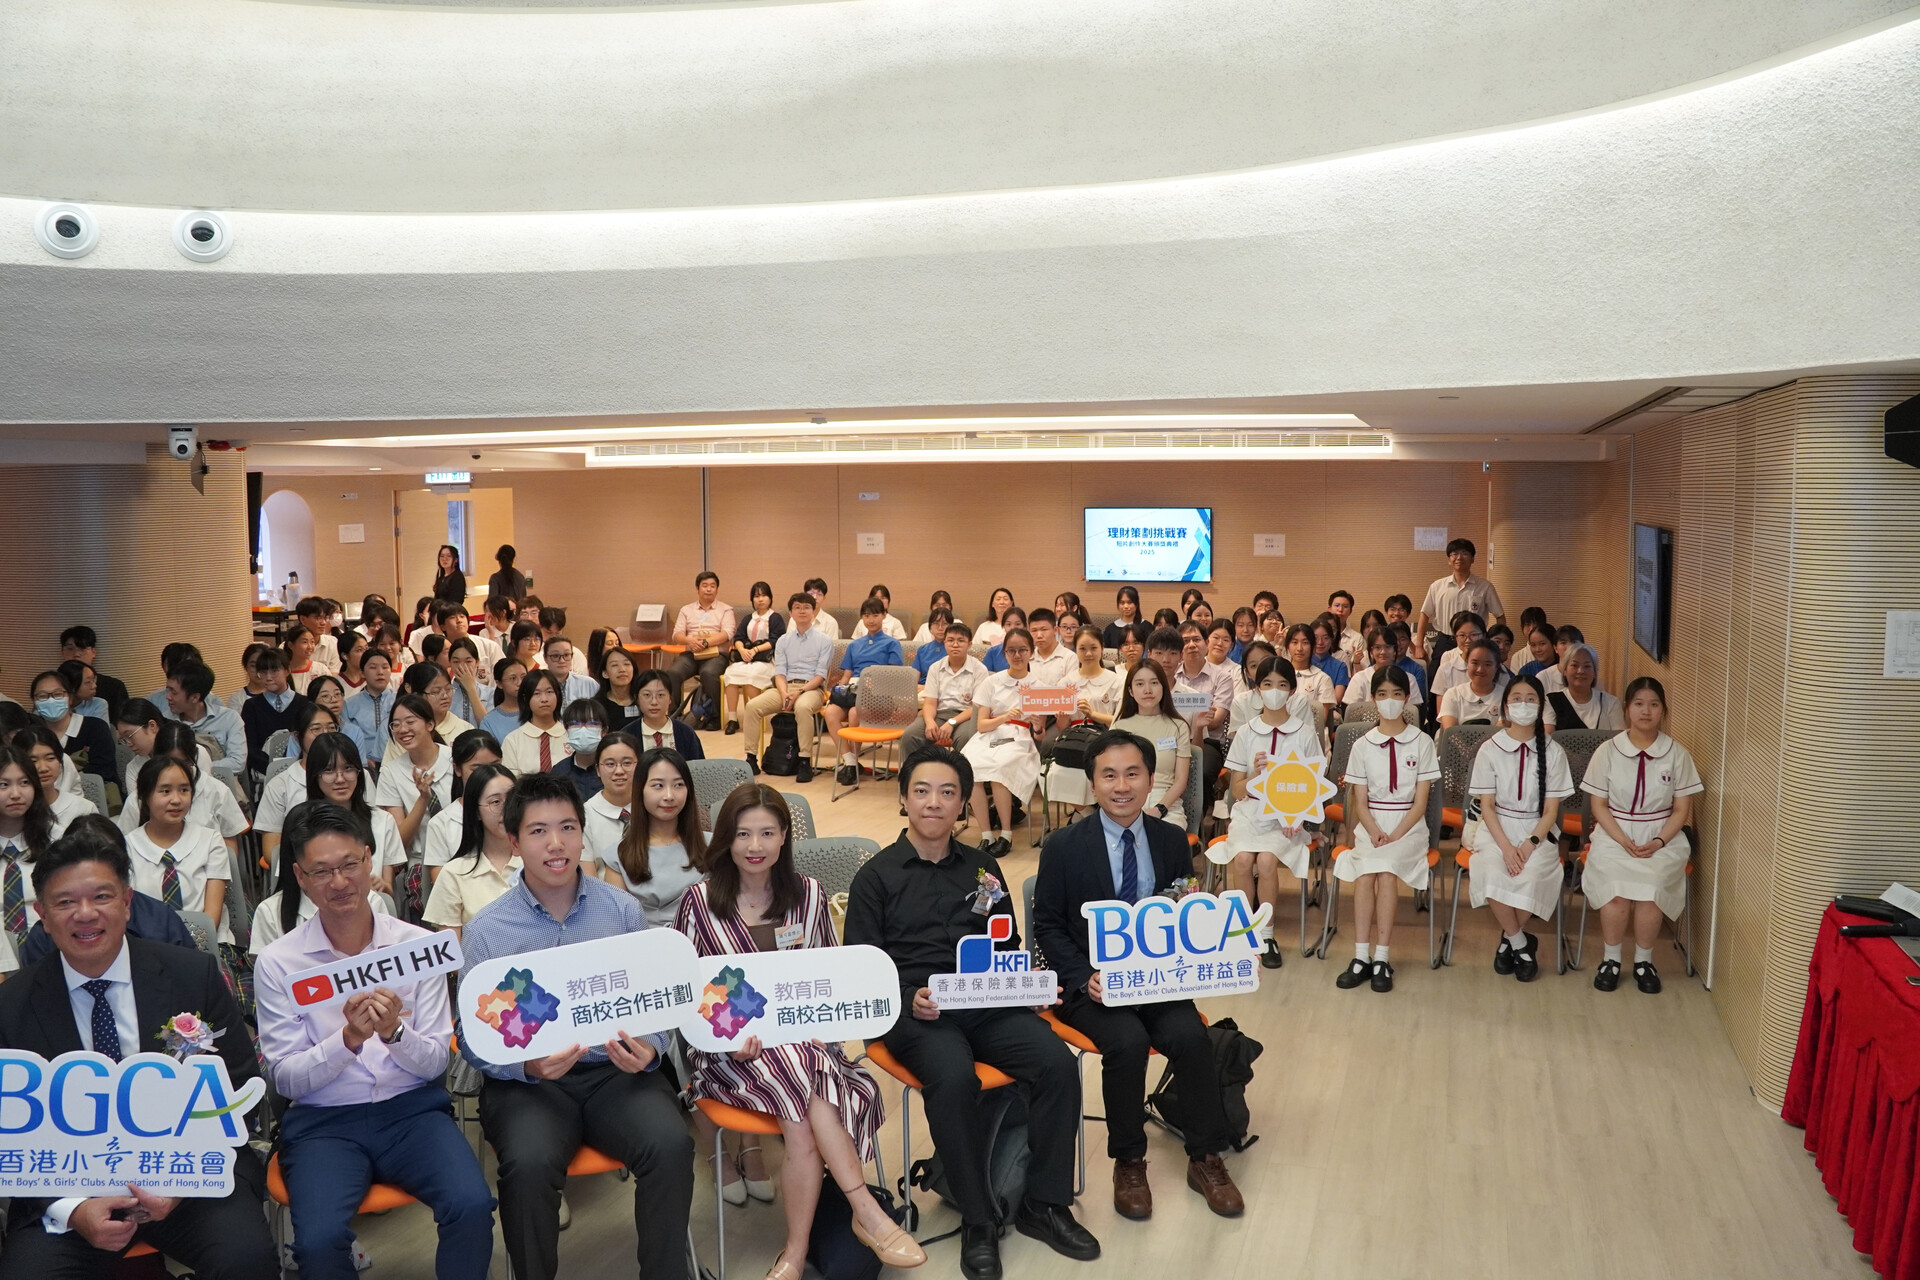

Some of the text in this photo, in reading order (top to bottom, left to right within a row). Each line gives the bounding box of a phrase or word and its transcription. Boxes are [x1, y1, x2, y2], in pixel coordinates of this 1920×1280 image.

[1107, 527, 1187, 539] 理財策劃挑戰賽
[1022, 695, 1074, 707] Congrats!
[1088, 896, 1266, 963] BGCA
[333, 940, 456, 993] HKFI HK
[994, 954, 1029, 972] HKFI
[1107, 955, 1253, 990] 香港小童群益會
[566, 969, 629, 1001] 教育局
[774, 978, 832, 1002] 教育局
[937, 974, 1050, 992] 香港保險業聯會
[1179, 984, 1212, 992] Association
[1222, 981, 1238, 989] Hong
[571, 982, 694, 1027] 商校合作計劃
[776, 997, 891, 1026] 商校合作計劃
[949, 996, 967, 1004] Hong
[967, 995, 985, 1003] Kong
[986, 994, 1018, 1002] Federation
[0, 1058, 255, 1137] BGCA
[0, 1137, 225, 1175] 香港小童群益會
[43, 1177, 51, 1186] &
[81, 1177, 105, 1187] Clubs
[163, 1178, 173, 1187] of
[176, 1178, 200, 1189] Hong
[202, 1178, 225, 1189] Kong
